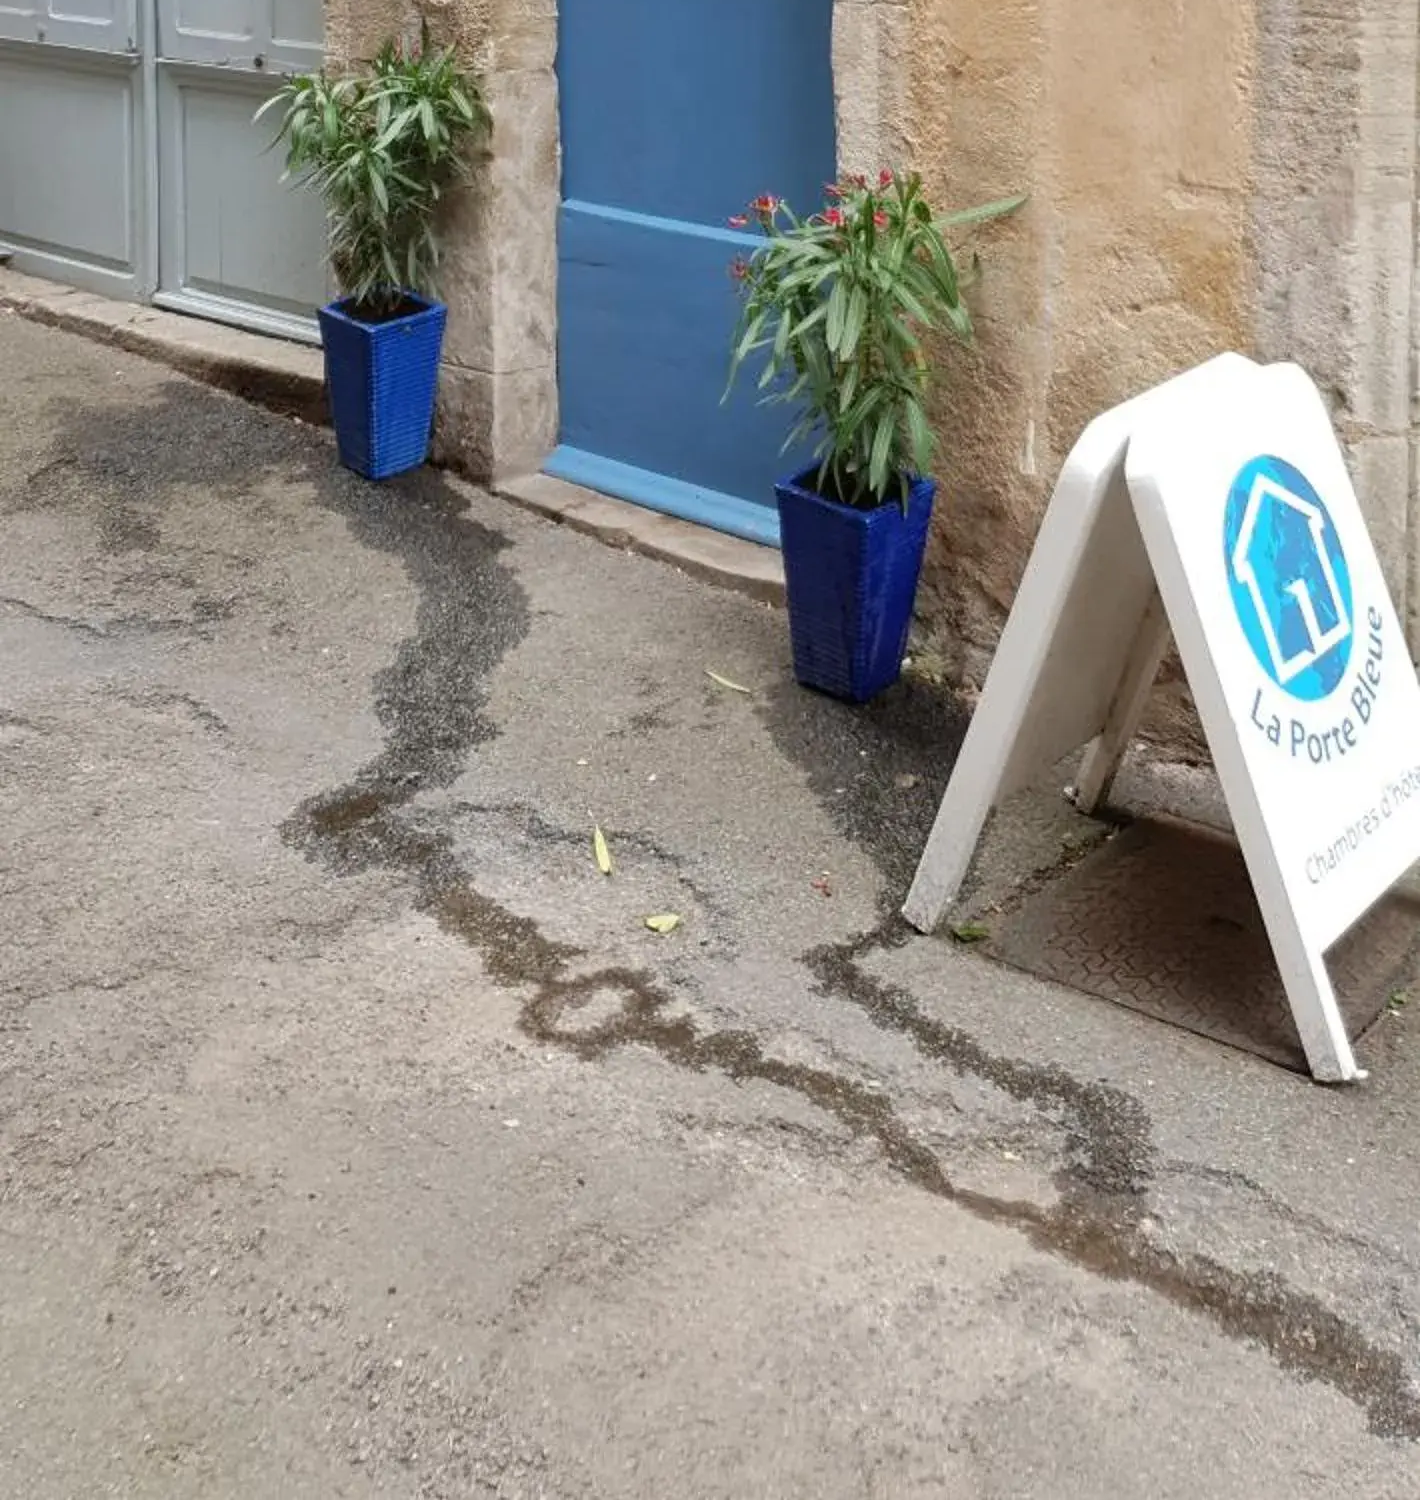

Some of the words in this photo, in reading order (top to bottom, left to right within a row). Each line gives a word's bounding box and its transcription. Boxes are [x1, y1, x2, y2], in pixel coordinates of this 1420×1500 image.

[1251, 687, 1282, 746] La
[1290, 717, 1357, 764] Porte
[1350, 606, 1383, 725] Bleue
[1305, 807, 1380, 884] Chambres
